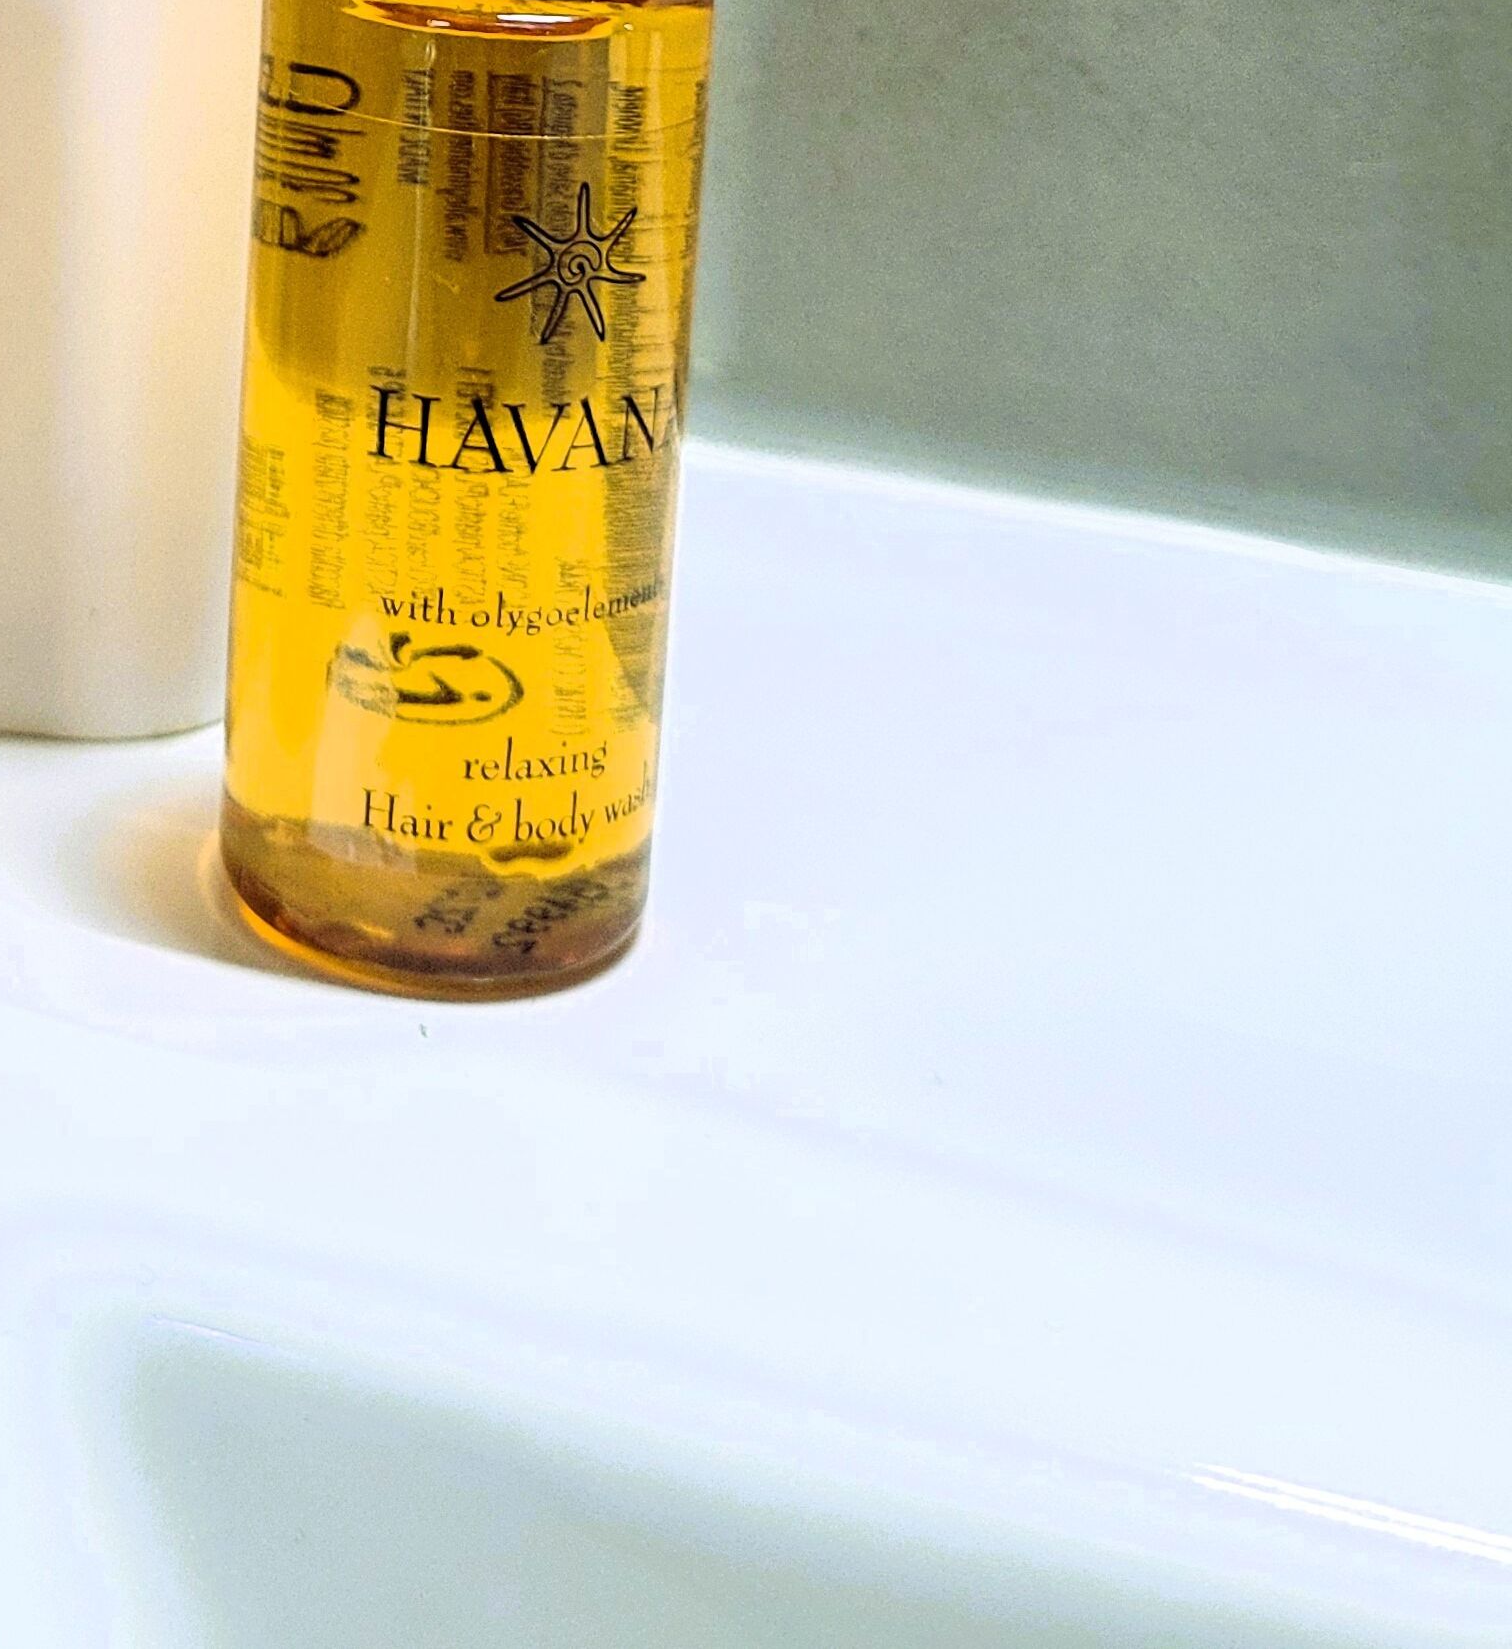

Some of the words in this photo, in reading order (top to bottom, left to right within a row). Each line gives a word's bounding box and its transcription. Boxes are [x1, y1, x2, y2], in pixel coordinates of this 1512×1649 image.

[380, 586, 457, 625] with
[470, 572, 665, 636] olygoelement
[461, 736, 608, 782] relaxing
[362, 787, 453, 842] Hair
[465, 803, 503, 844] &
[514, 790, 596, 845] body
